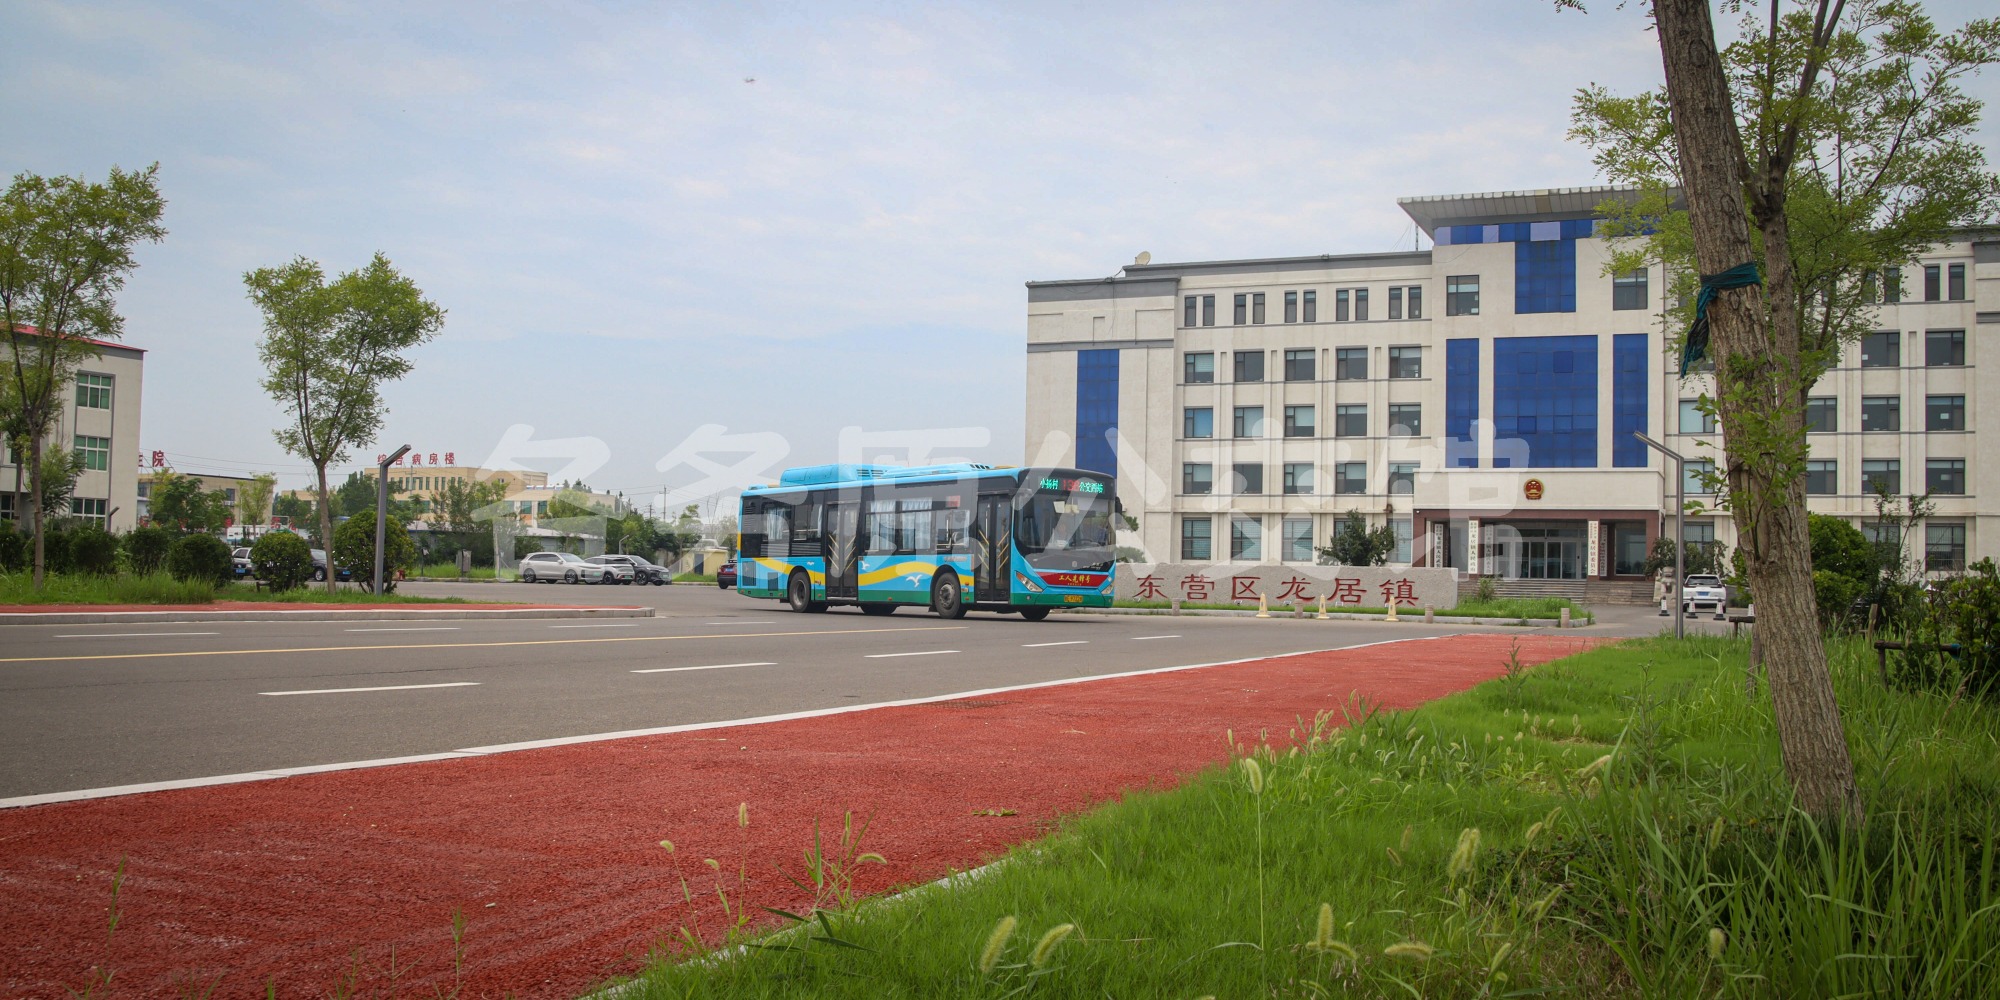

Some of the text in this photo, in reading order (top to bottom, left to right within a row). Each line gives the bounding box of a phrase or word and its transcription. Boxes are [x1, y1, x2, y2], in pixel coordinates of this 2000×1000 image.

[1132, 573, 1420, 606] 东营区龙居镇
